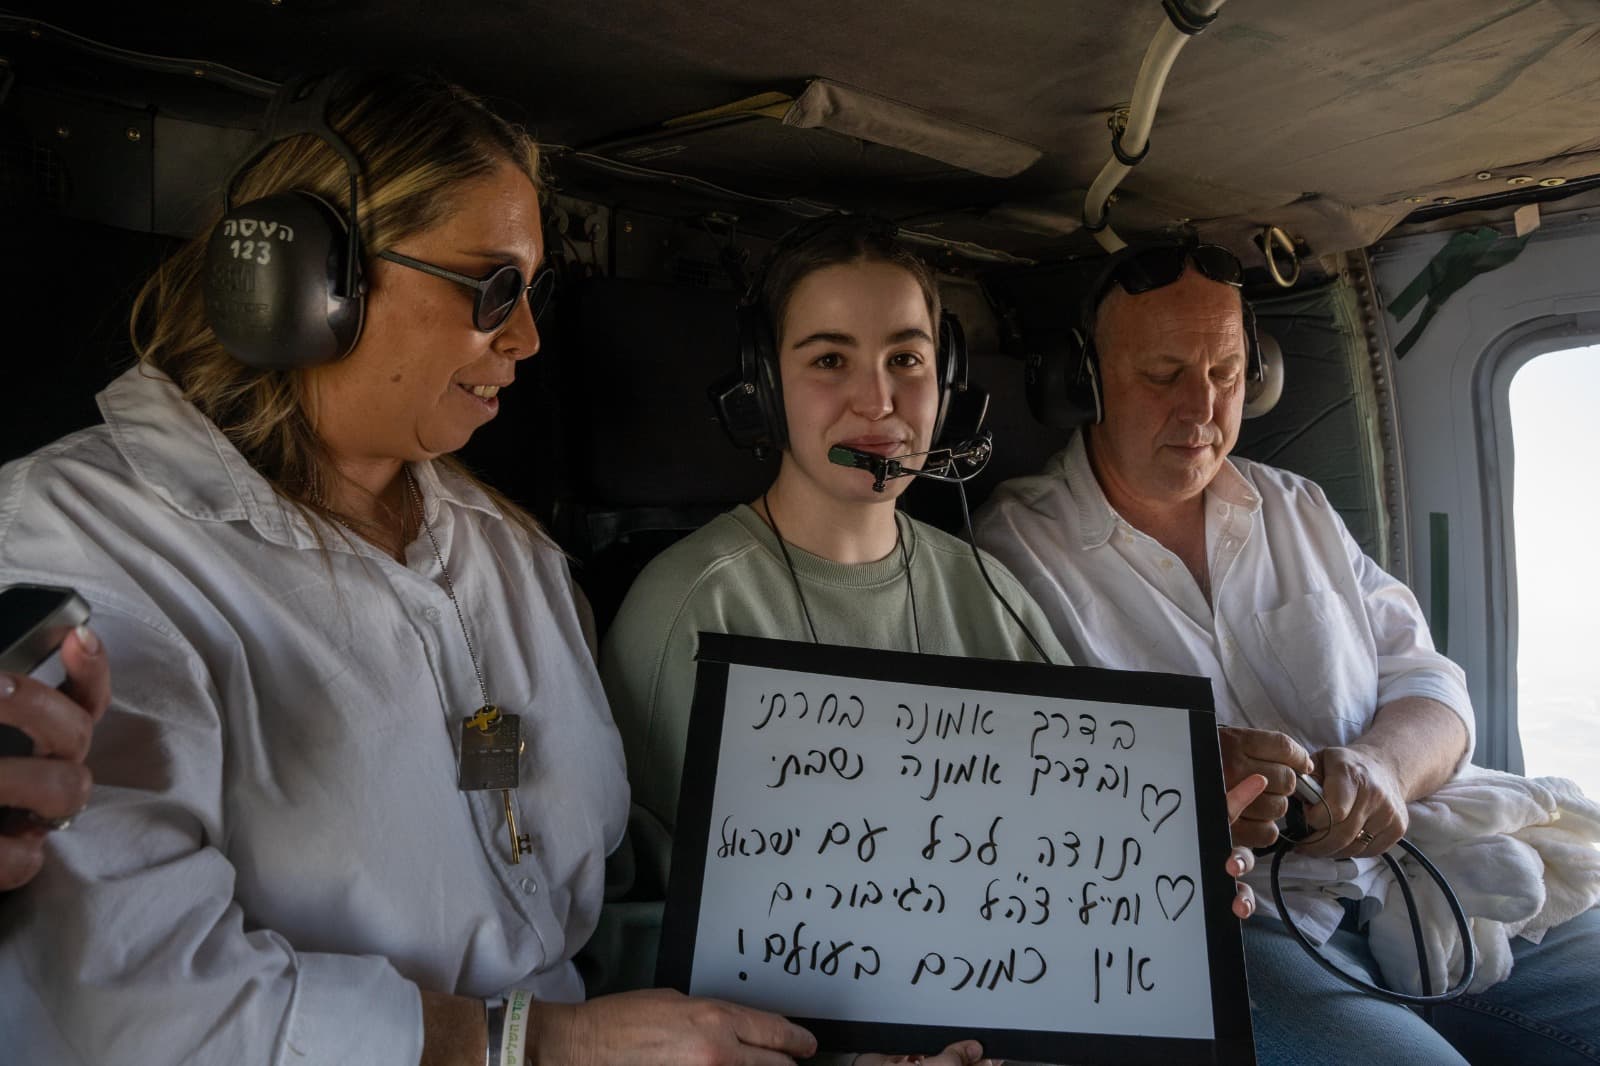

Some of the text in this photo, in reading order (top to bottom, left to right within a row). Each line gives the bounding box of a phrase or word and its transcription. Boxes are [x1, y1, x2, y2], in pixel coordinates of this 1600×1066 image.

[230, 240, 271, 265] 123
[752, 691, 1135, 758] בדרך אמונה בחרתי
[901, 754, 1002, 801] אמונה
[1030, 754, 1129, 799] ובדרך
[717, 815, 1141, 881] תודה לכל עם ישראל
[768, 877, 945, 918] הגיבורים
[910, 947, 1047, 991] כמוכם
[1094, 946, 1155, 1004] אין
